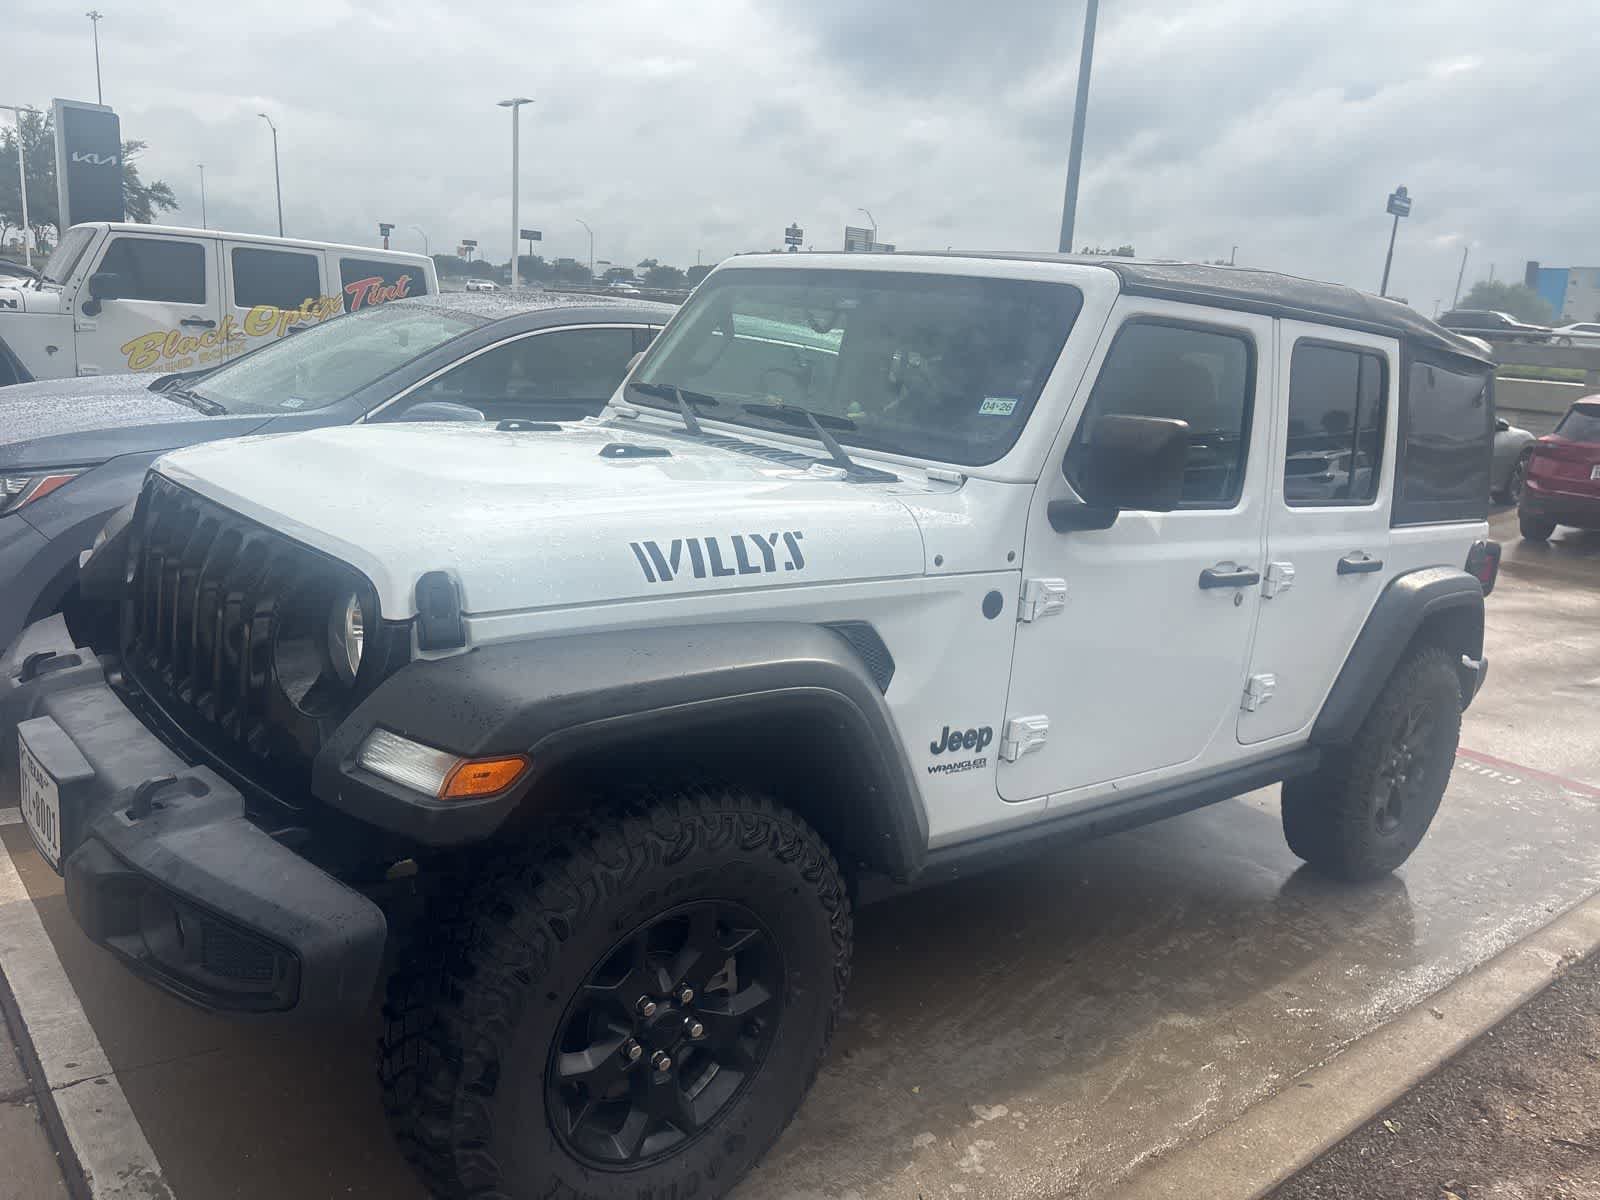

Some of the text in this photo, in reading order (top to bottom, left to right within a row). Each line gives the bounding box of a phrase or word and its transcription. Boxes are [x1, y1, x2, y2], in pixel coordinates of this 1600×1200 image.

[121, 314, 245, 370] Black
[344, 274, 412, 311] Tint
[629, 530, 805, 583] WILLYS
[930, 726, 993, 755] Jeep
[927, 758, 987, 774] WRANGLER
